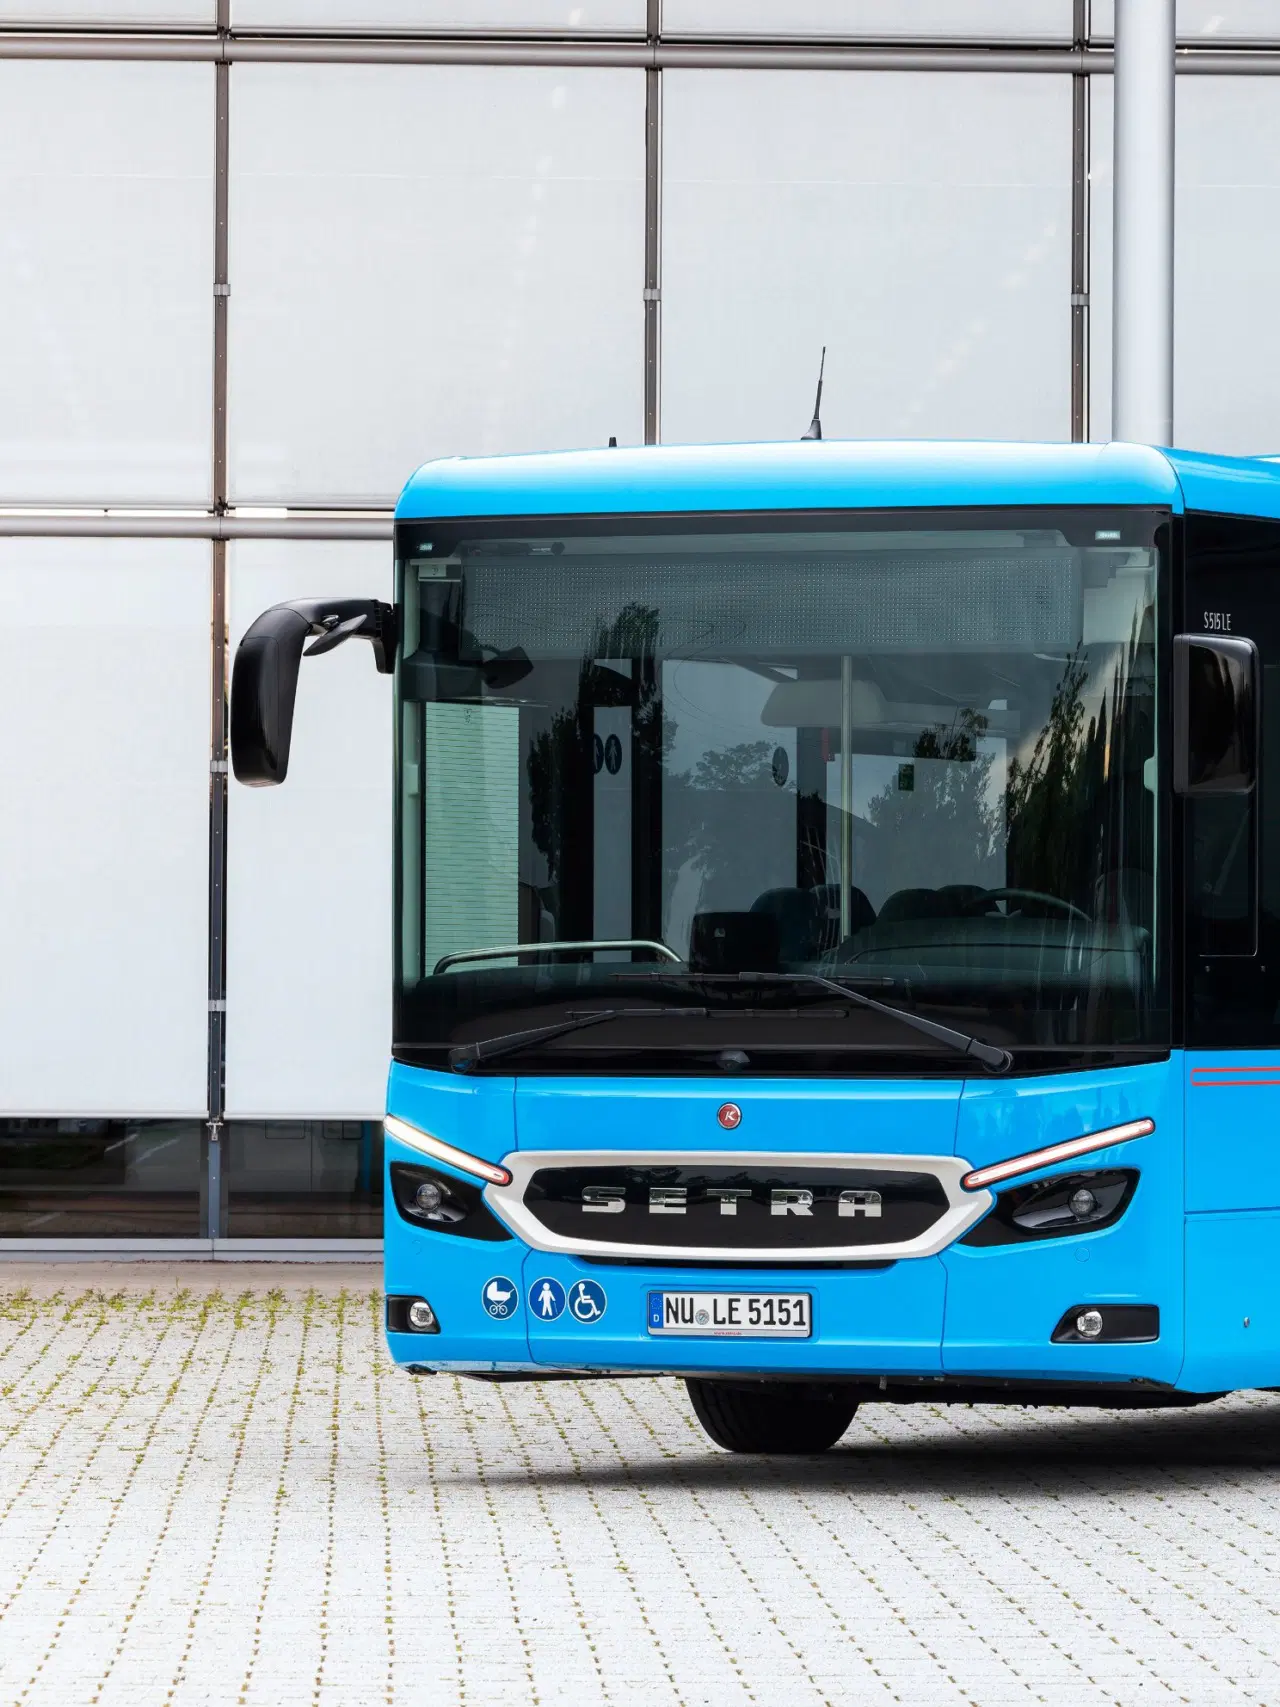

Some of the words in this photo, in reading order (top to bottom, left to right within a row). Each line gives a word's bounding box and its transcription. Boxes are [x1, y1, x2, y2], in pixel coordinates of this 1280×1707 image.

[582, 1186, 882, 1217] SETRA
[653, 1315, 660, 1323] D
[665, 1297, 694, 1324] NU
[713, 1298, 742, 1325] LE
[748, 1298, 806, 1326] 5151
